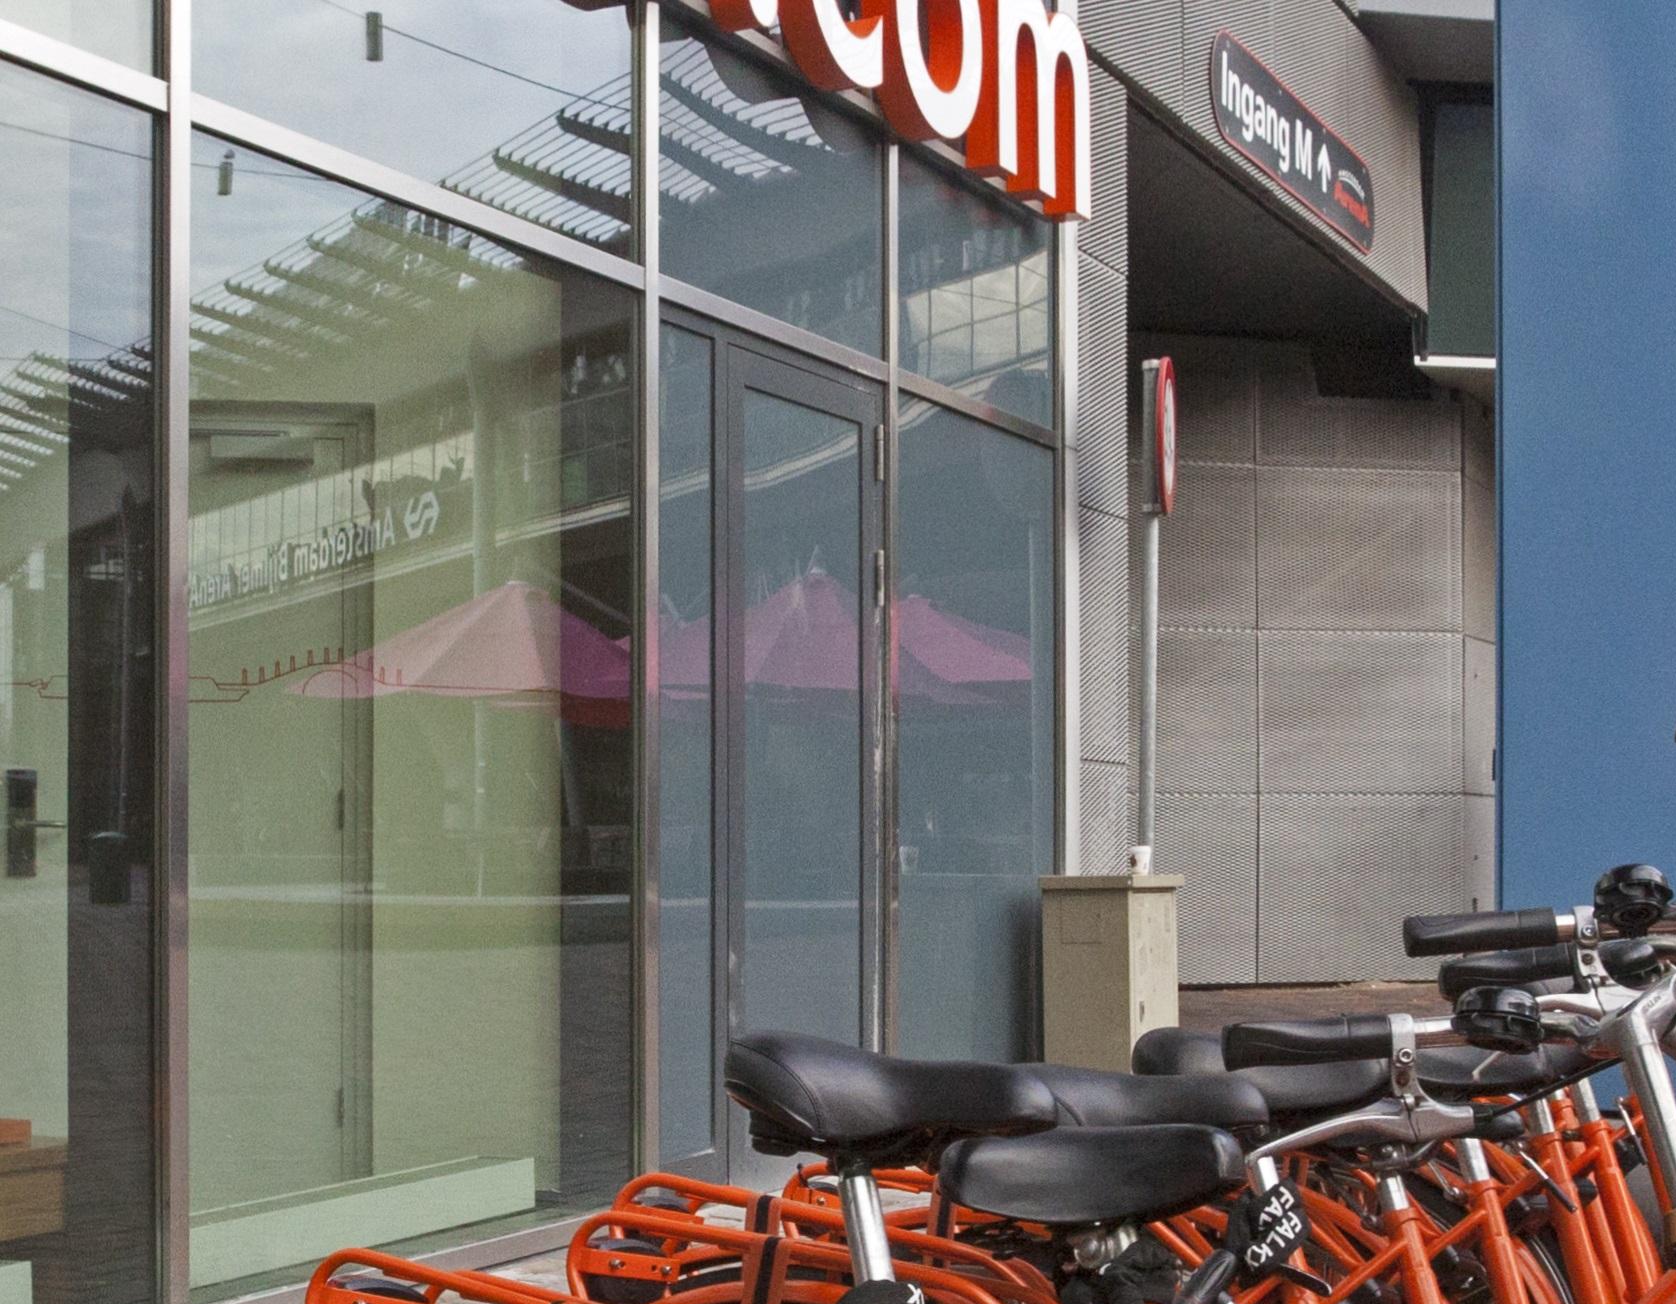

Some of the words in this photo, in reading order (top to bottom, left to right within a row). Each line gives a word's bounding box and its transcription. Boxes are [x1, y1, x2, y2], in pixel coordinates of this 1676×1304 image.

[1221, 50, 1290, 173] Ingang
[1294, 118, 1313, 181] M
[1257, 1185, 1295, 1232] FAL
